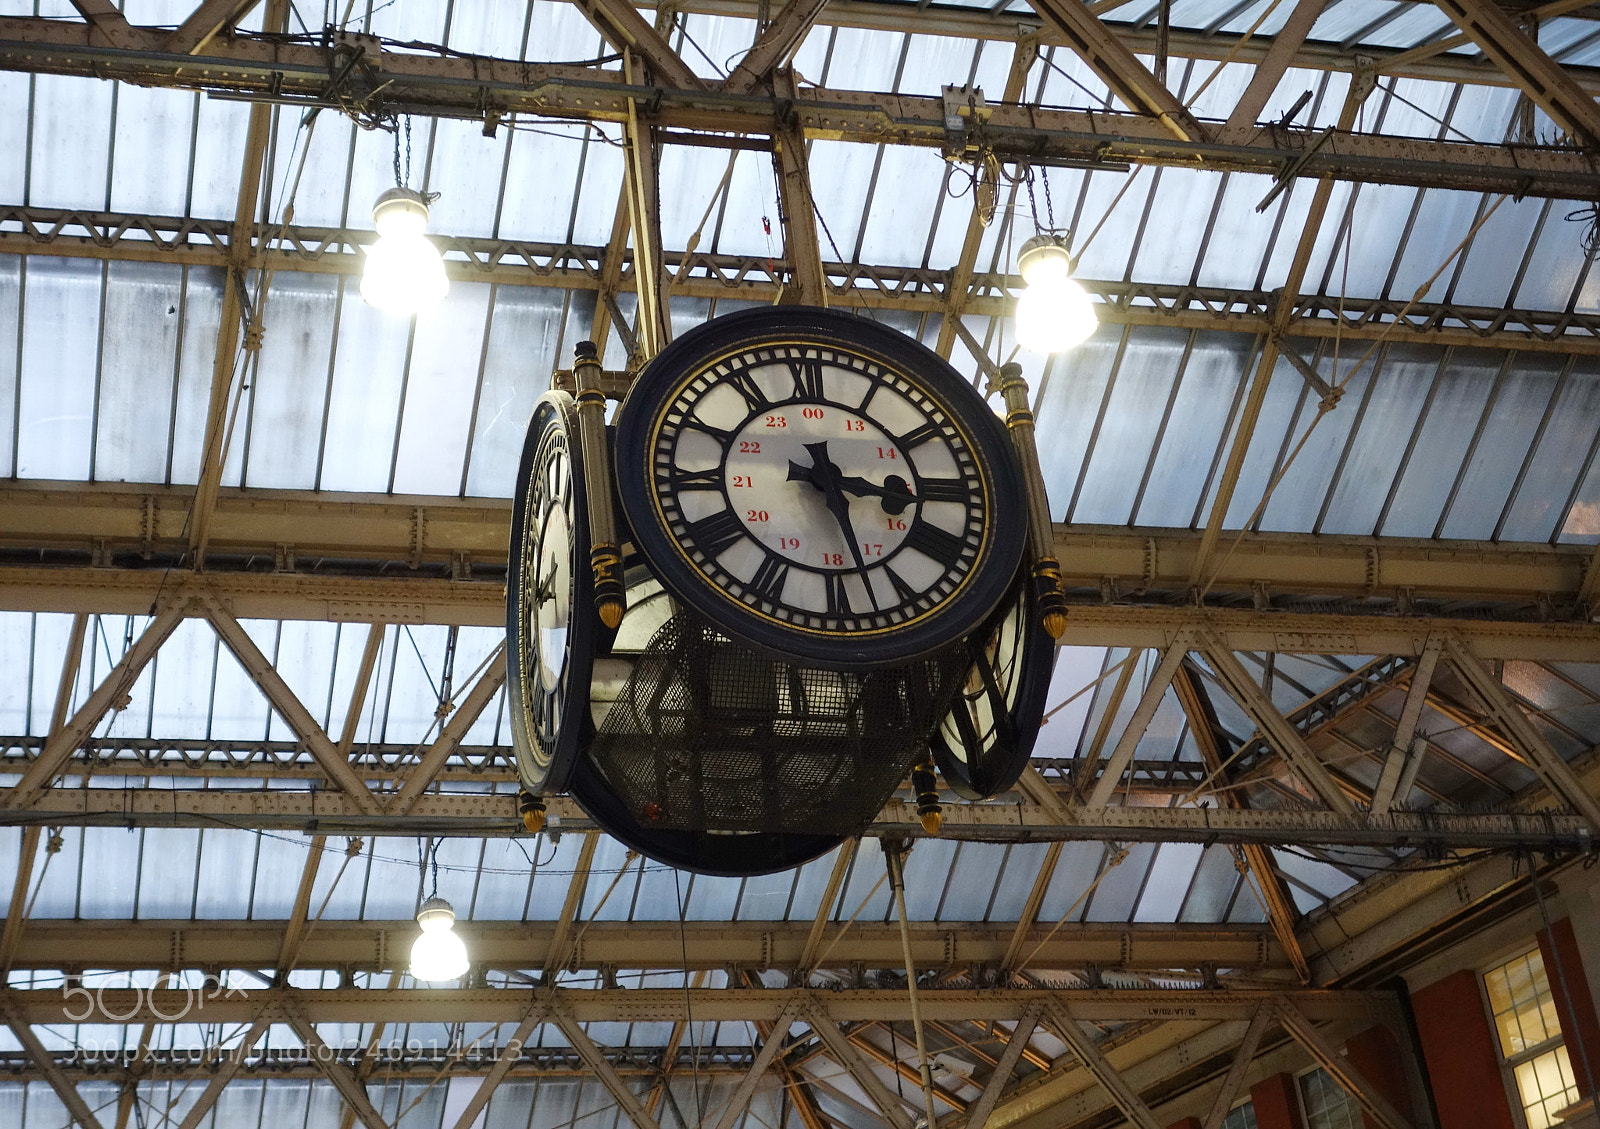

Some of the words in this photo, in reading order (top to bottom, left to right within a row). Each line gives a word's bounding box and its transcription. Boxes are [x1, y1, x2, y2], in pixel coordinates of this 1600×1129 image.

[801, 408, 825, 419] 00
[765, 416, 788, 428] 23
[845, 420, 866, 431] 13
[739, 442, 761, 453] 22
[877, 447, 897, 459] 14
[732, 476, 753, 488] 21
[746, 510, 770, 522] 20
[887, 519, 908, 530] 16
[780, 538, 800, 549] 19
[865, 544, 883, 555] 17
[823, 554, 844, 565] 18
